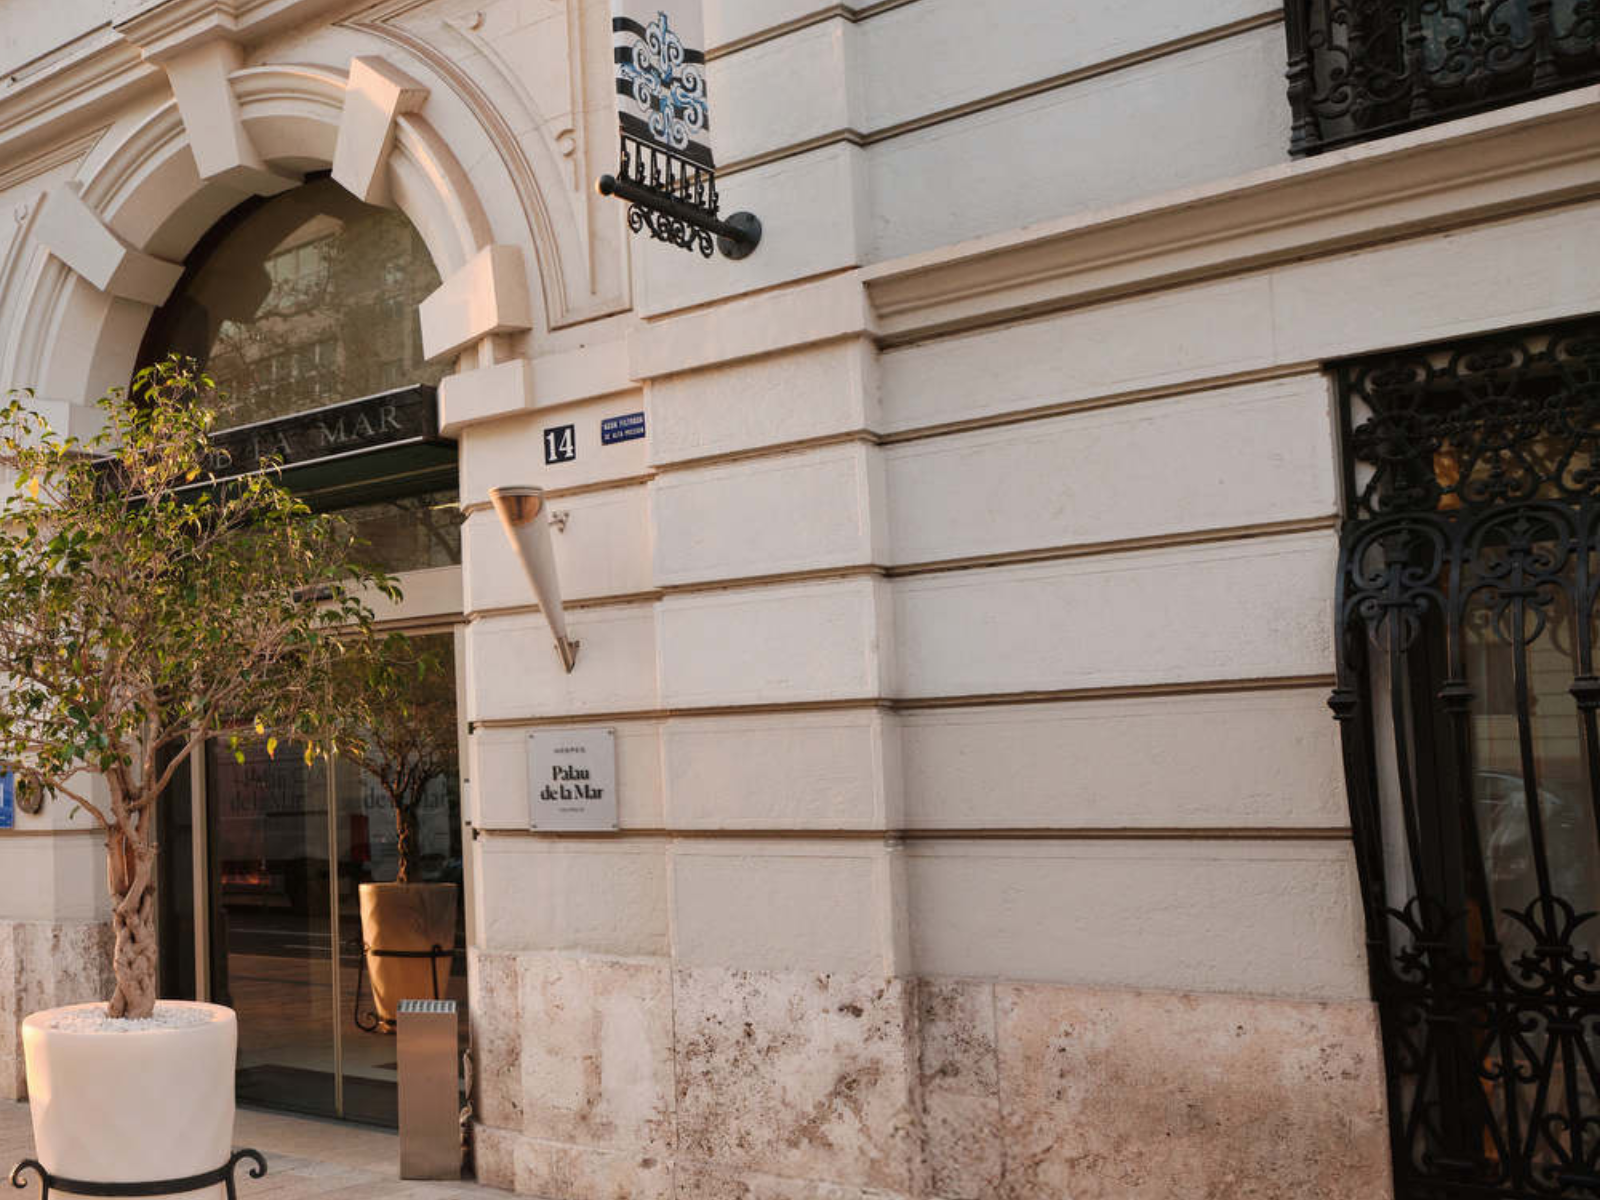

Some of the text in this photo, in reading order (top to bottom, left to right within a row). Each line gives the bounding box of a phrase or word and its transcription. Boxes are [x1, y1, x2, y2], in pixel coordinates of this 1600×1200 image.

[319, 405, 402, 446] MAR
[546, 427, 575, 462] 14
[551, 764, 590, 781] Palau
[540, 784, 604, 801] de la Mar
